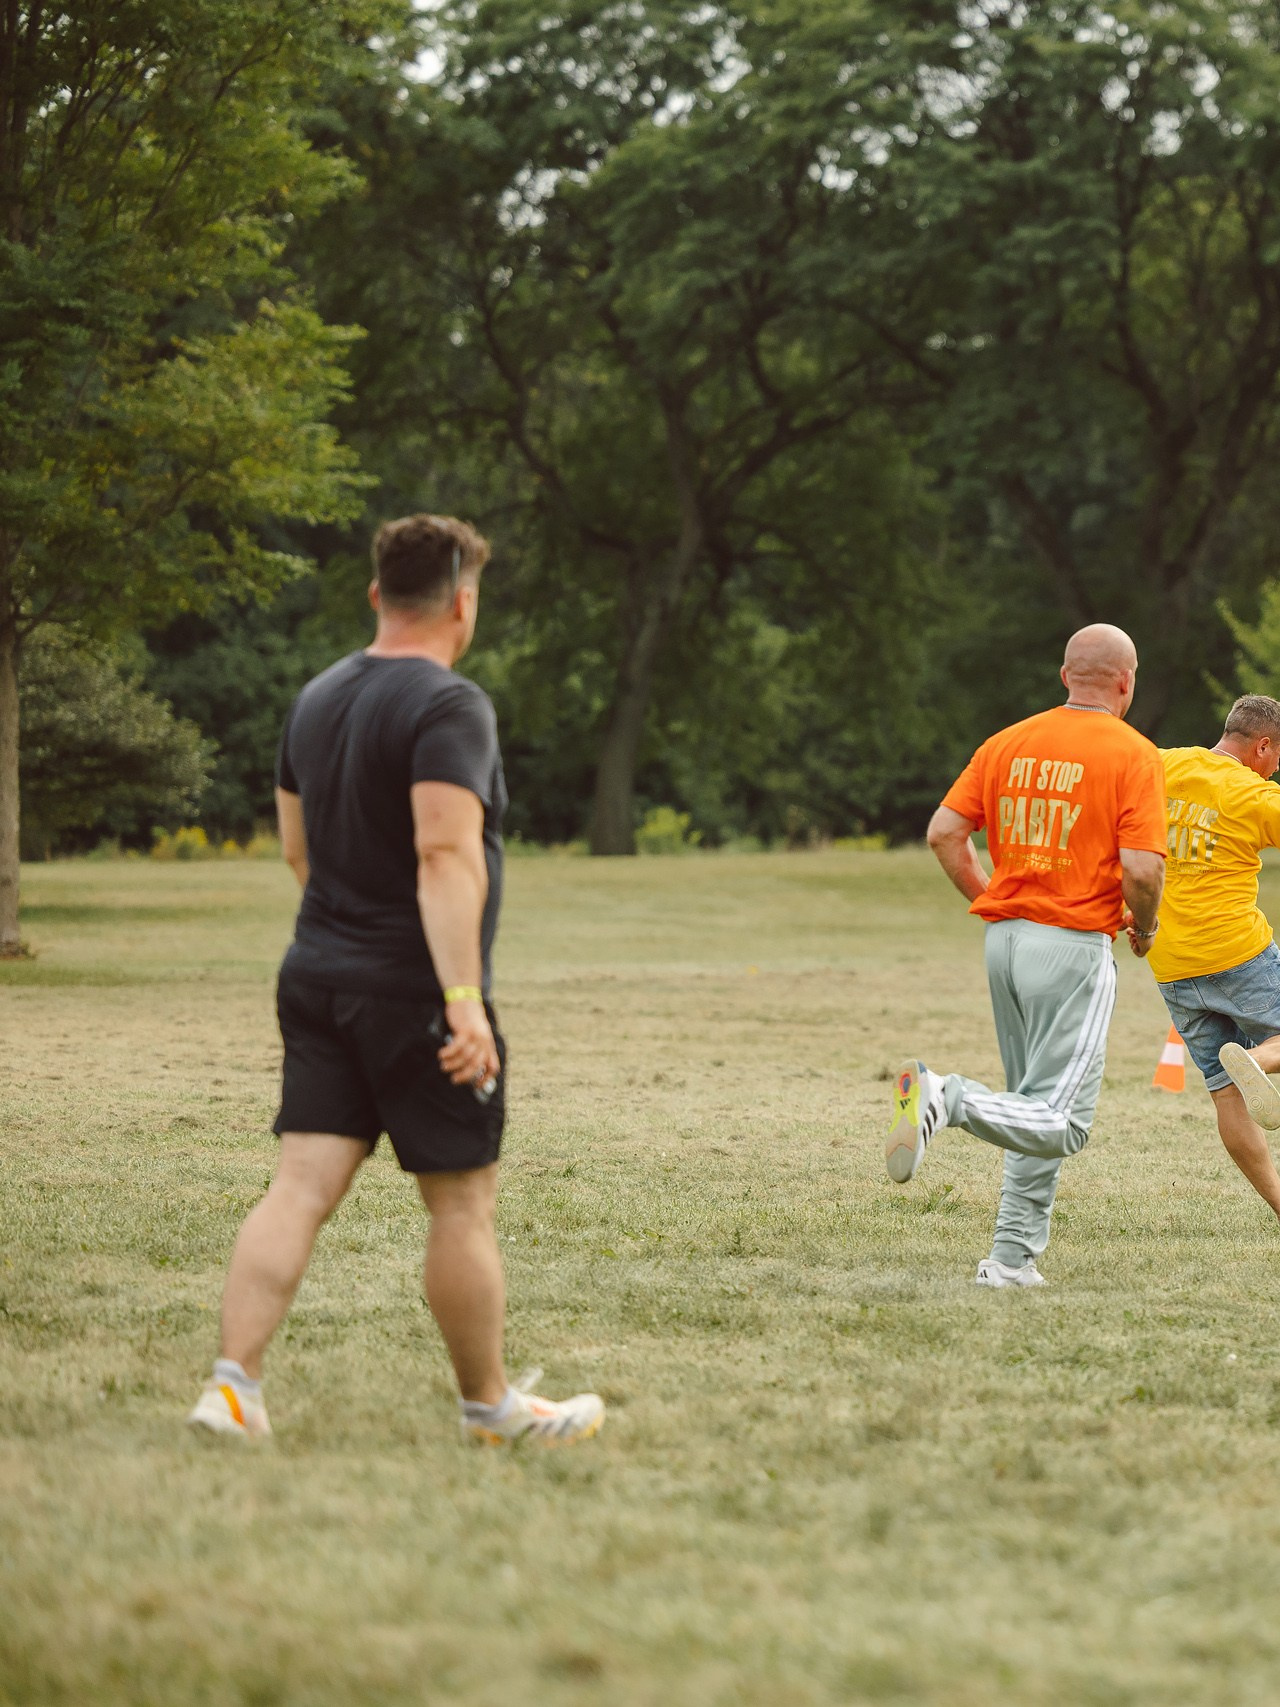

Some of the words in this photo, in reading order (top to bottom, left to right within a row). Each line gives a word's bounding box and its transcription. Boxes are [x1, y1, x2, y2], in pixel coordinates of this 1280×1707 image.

[1007, 757, 1037, 788] PIT
[1036, 759, 1085, 794] STOP
[999, 796, 1083, 850] PARTY
[1184, 803, 1219, 829] STOP
